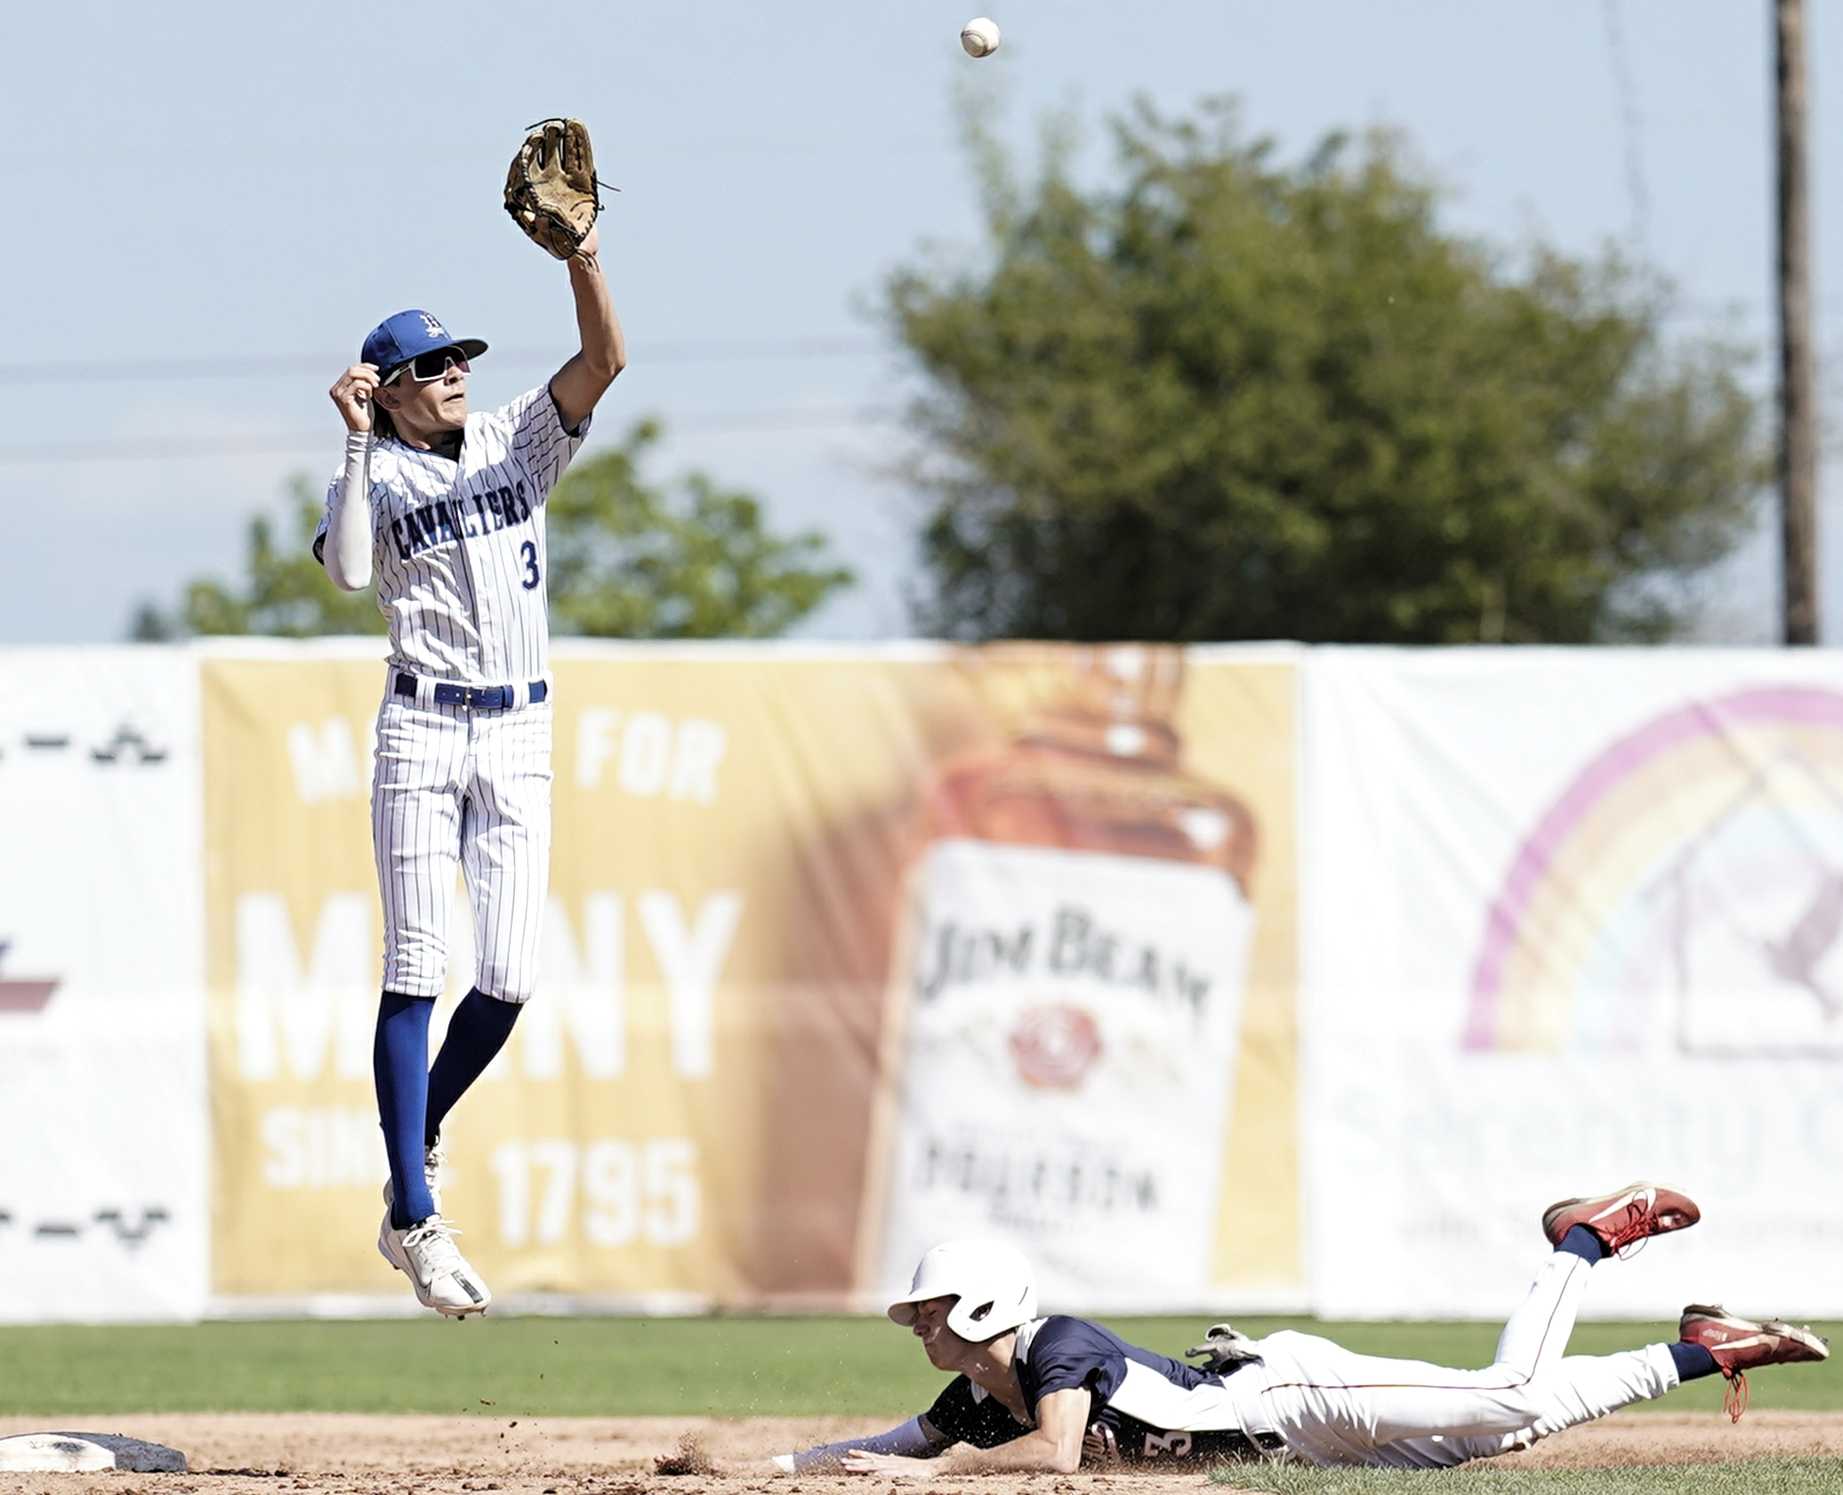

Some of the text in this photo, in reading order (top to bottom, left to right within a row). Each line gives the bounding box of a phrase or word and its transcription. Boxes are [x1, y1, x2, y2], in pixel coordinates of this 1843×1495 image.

[391, 479, 530, 560] CAVALIERS
[520, 540, 540, 590] 3
[575, 708, 727, 805] FOR
[235, 890, 744, 1081] MNY
[490, 1137, 703, 1247] 1795
